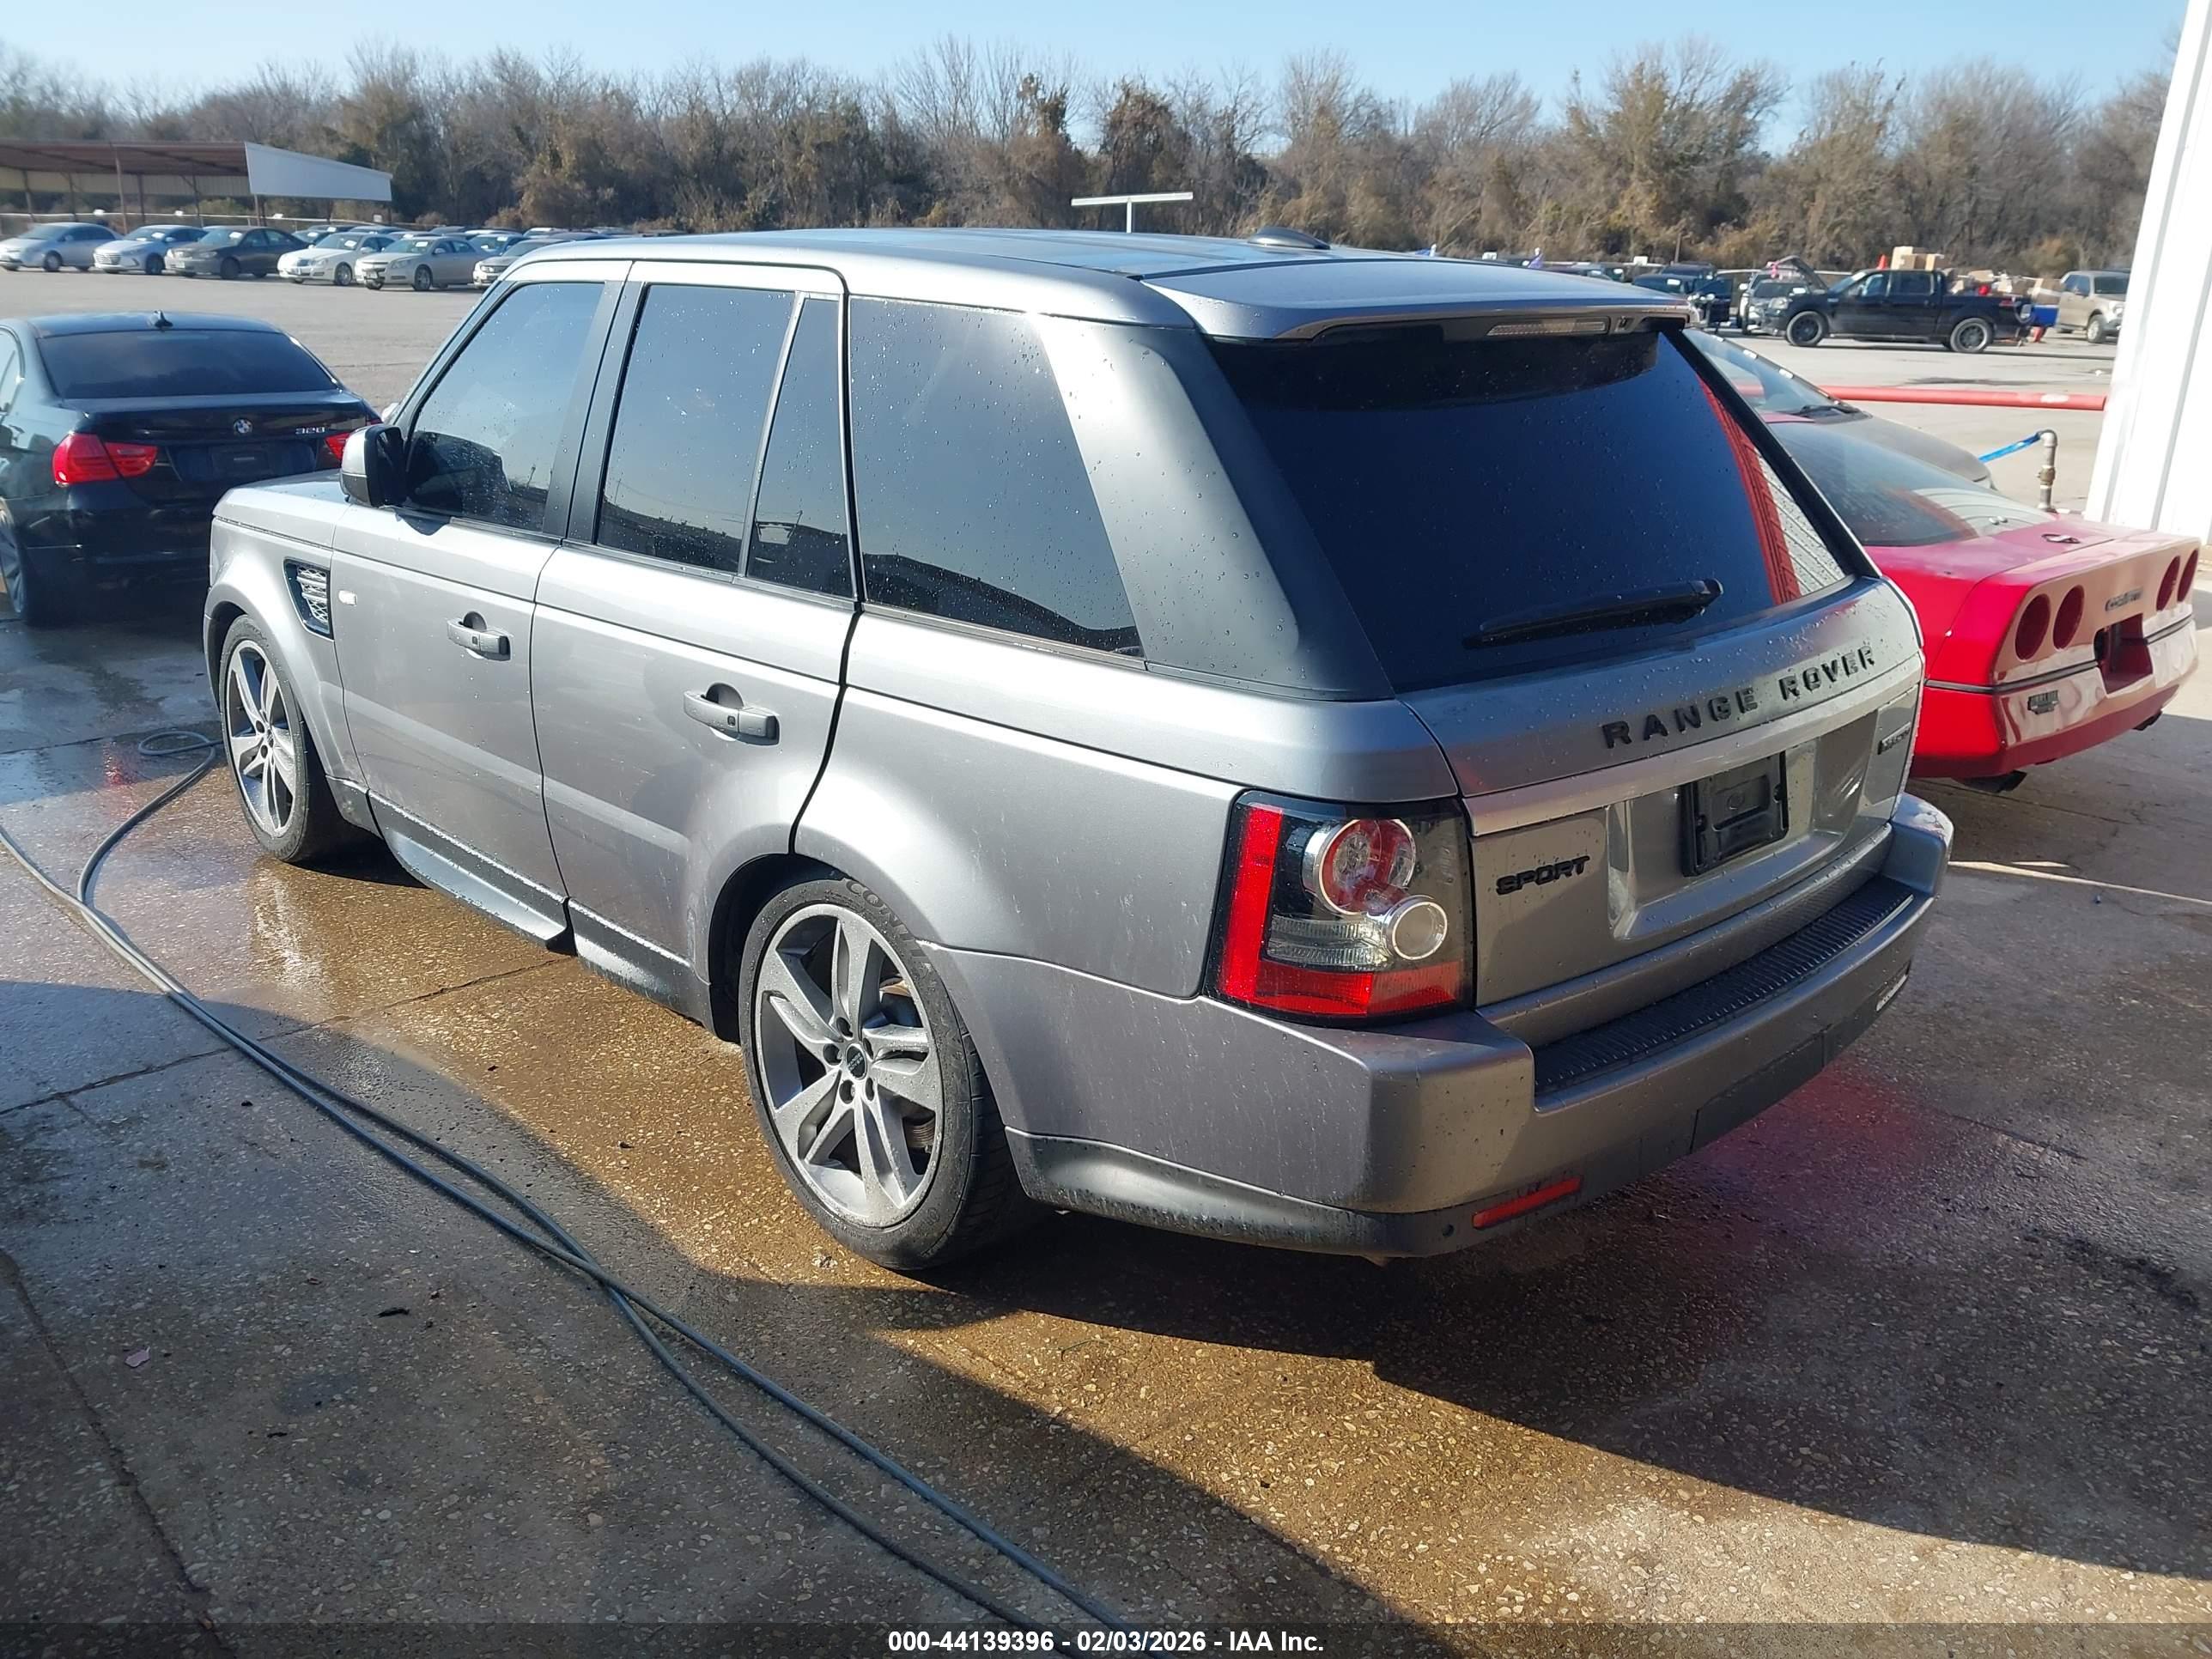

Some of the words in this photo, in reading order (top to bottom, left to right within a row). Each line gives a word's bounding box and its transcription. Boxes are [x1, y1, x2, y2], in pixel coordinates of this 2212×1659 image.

[1601, 686, 1759, 749] RANGE
[1778, 646, 1875, 702] ROVER
[1496, 855, 1590, 896] SPORT
